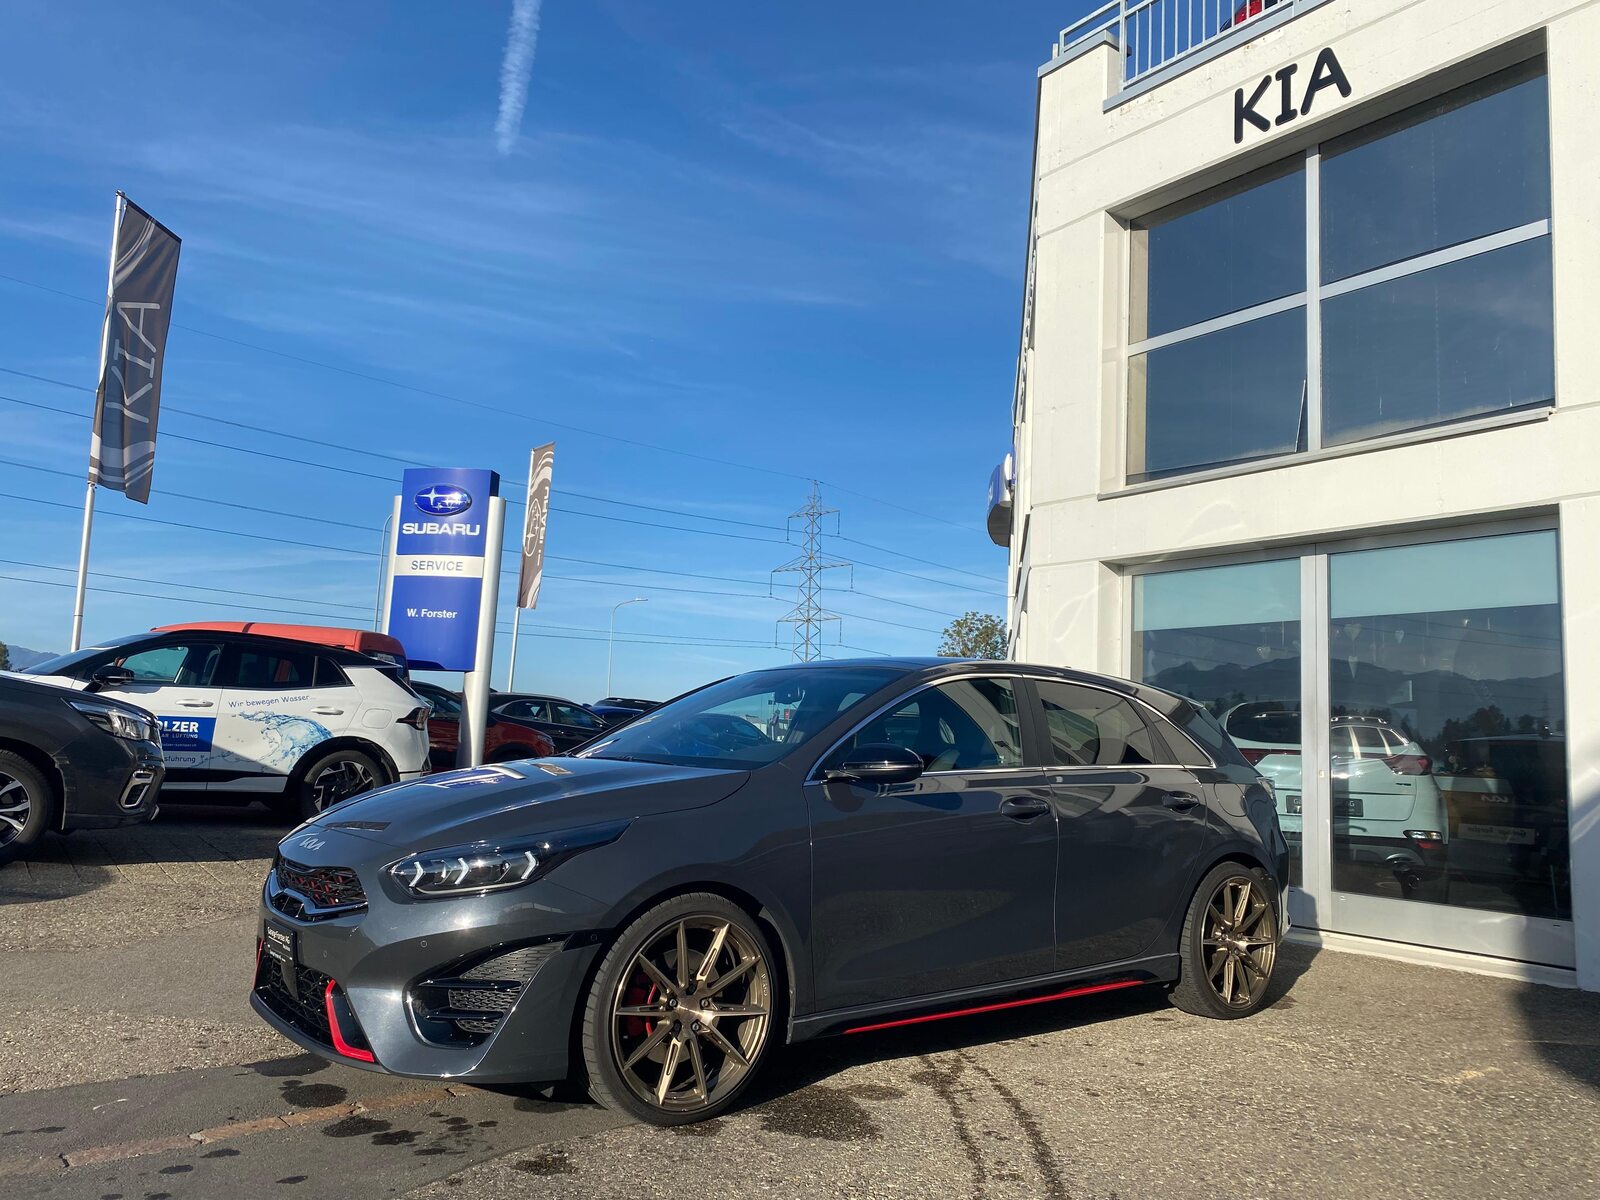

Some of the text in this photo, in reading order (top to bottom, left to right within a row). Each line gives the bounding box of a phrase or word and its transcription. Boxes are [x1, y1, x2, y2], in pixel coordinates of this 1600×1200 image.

[1234, 47, 1352, 144] KIA
[105, 301, 161, 424] KIA
[402, 522, 481, 536] SUBARU
[411, 560, 464, 572] SERVICE
[406, 608, 458, 620] W. Forster
[228, 694, 310, 708] Wir bewegen Wasser
